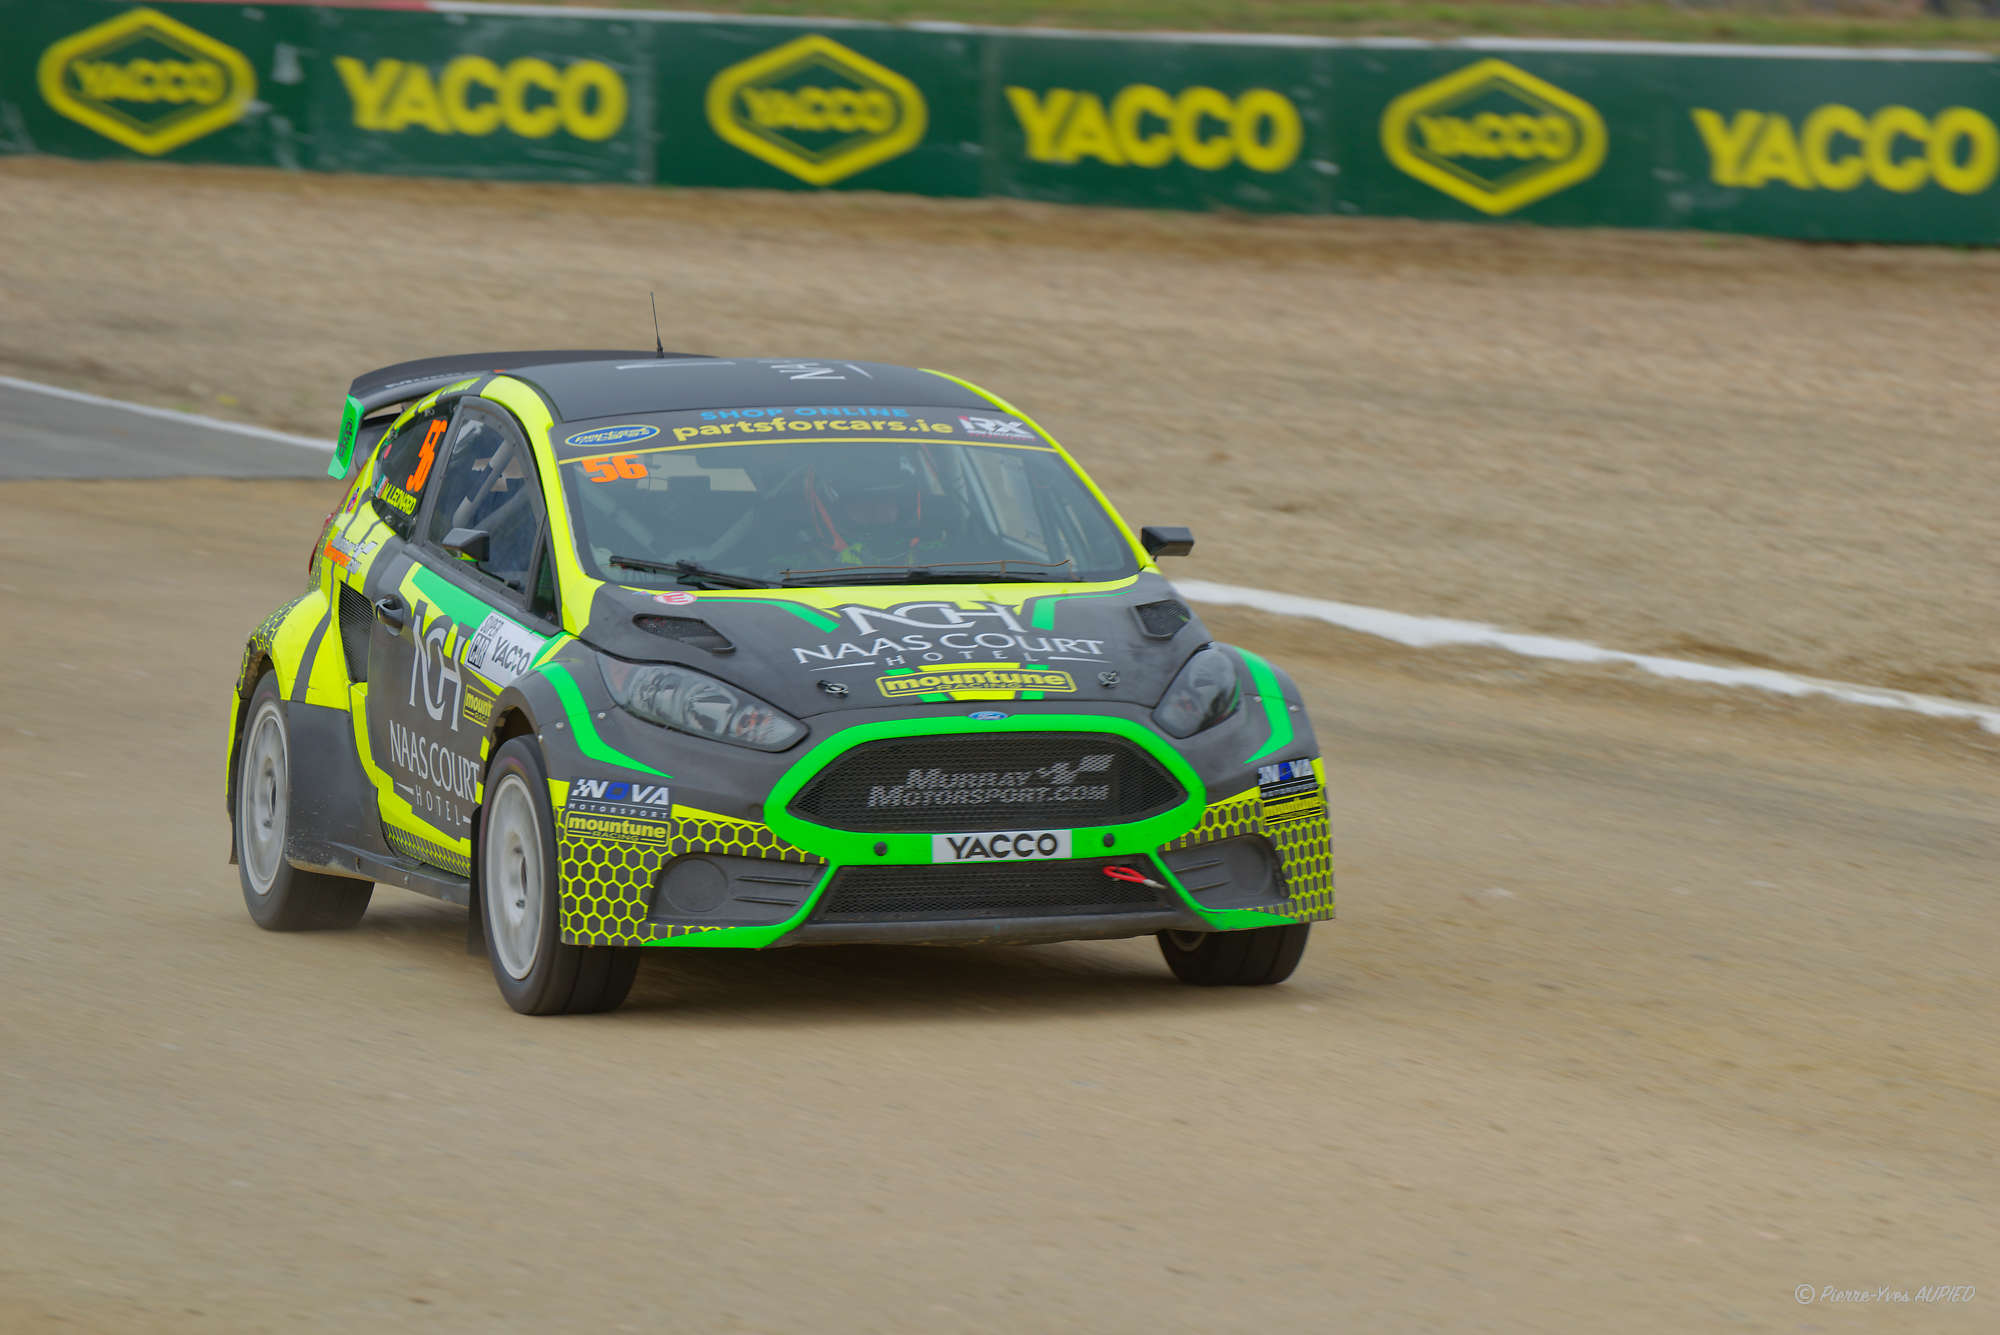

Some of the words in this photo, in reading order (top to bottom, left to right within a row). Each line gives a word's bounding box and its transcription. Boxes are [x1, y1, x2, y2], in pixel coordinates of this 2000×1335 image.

[72, 59, 224, 104] YACCO
[335, 55, 628, 142] YACCO
[741, 86, 896, 133] YACCO
[1005, 84, 1303, 173] YACCO
[1416, 112, 1574, 160] YACCO
[1690, 104, 2000, 195] YACCO
[700, 407, 783, 421] SHOP
[794, 406, 910, 418] ONLINE
[672, 417, 954, 441] partsforcars.ie
[581, 454, 649, 483] 56
[792, 634, 934, 664] NAAS
[938, 632, 1105, 655] COURT
[884, 649, 1040, 666] HOTEL
[884, 671, 1066, 691] mountune
[389, 719, 427, 778] NAAS
[429, 742, 481, 803] COURT
[415, 784, 461, 827] HOTEL
[571, 778, 670, 806] NOVA
[568, 803, 669, 819] MOTORSPORT
[568, 817, 667, 839] mountune
[946, 832, 1058, 860] YACCO
